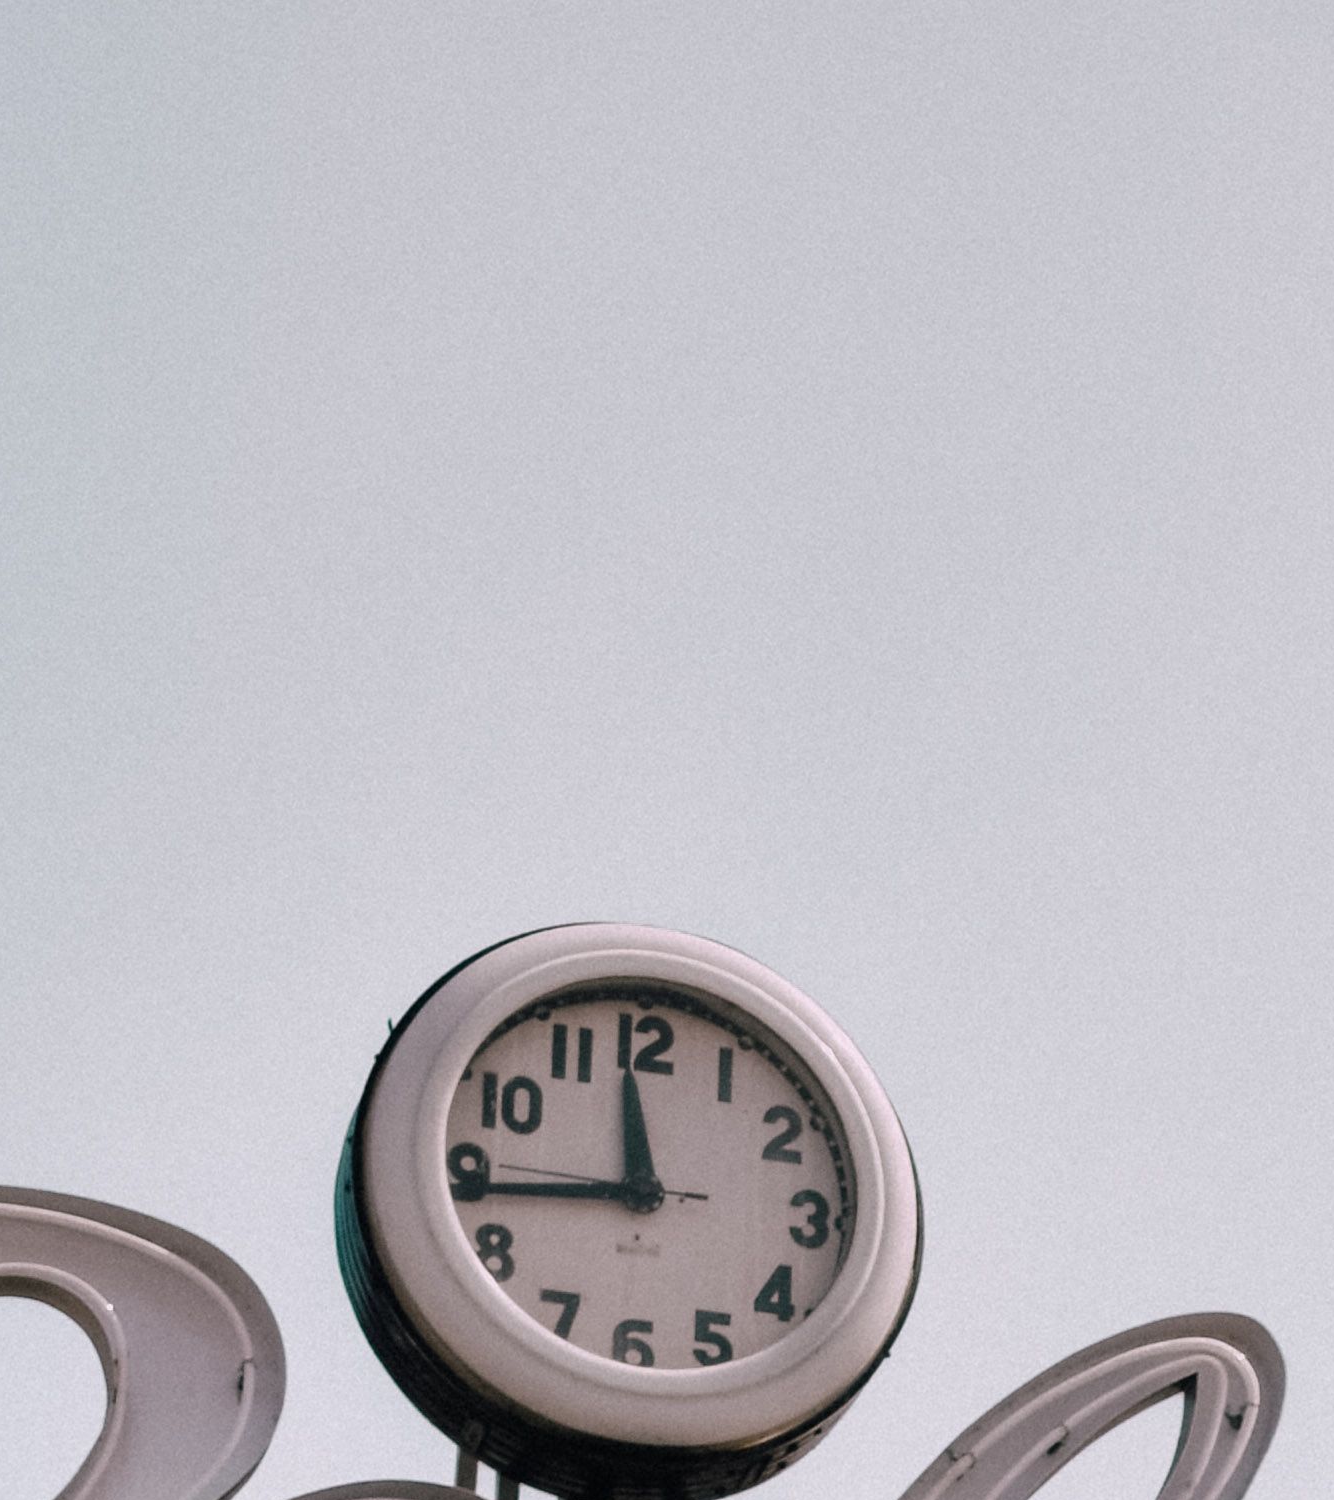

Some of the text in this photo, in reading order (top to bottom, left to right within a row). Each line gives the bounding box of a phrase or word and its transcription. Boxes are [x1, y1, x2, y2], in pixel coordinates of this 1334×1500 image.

[551, 1023, 593, 1083] 11
[618, 1013, 674, 1075] 12
[480, 1072, 543, 1135] 10
[717, 1046, 733, 1103] 1
[761, 1105, 804, 1164] 2
[789, 1189, 830, 1249] 3
[475, 1223, 515, 1283] 8
[539, 1289, 581, 1341] 7
[754, 1264, 796, 1322] 4
[611, 1319, 655, 1368] 6
[692, 1308, 734, 1366] 5
